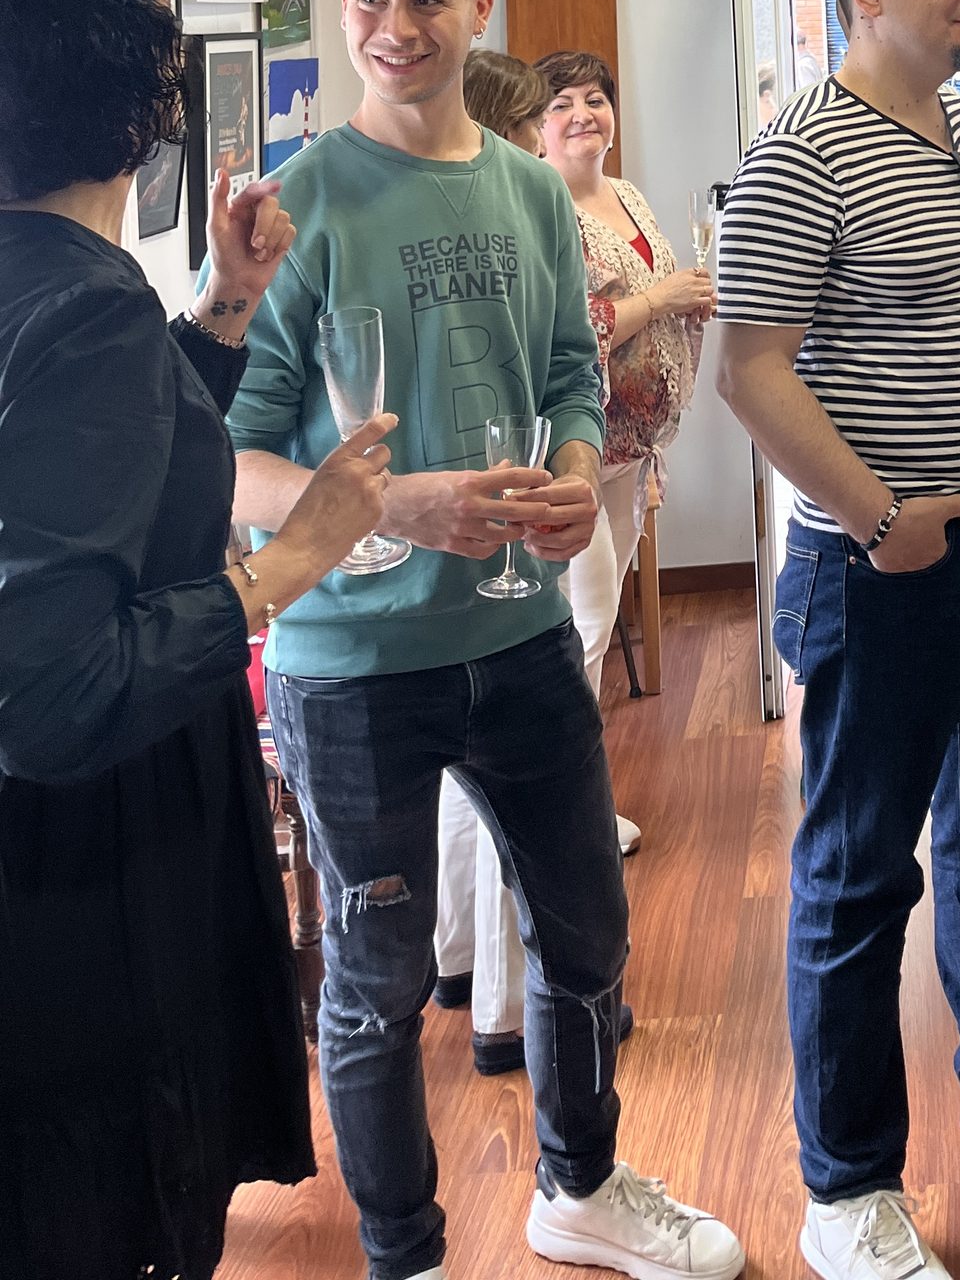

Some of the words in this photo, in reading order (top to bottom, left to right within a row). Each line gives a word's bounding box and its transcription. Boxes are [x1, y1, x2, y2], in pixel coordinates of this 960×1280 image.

[398, 233, 517, 266] BECAUSE
[404, 256, 468, 282] THERE
[475, 254, 492, 270] IS
[497, 255, 518, 271] NO
[407, 271, 518, 309] PLANET
[411, 298, 527, 467] B
